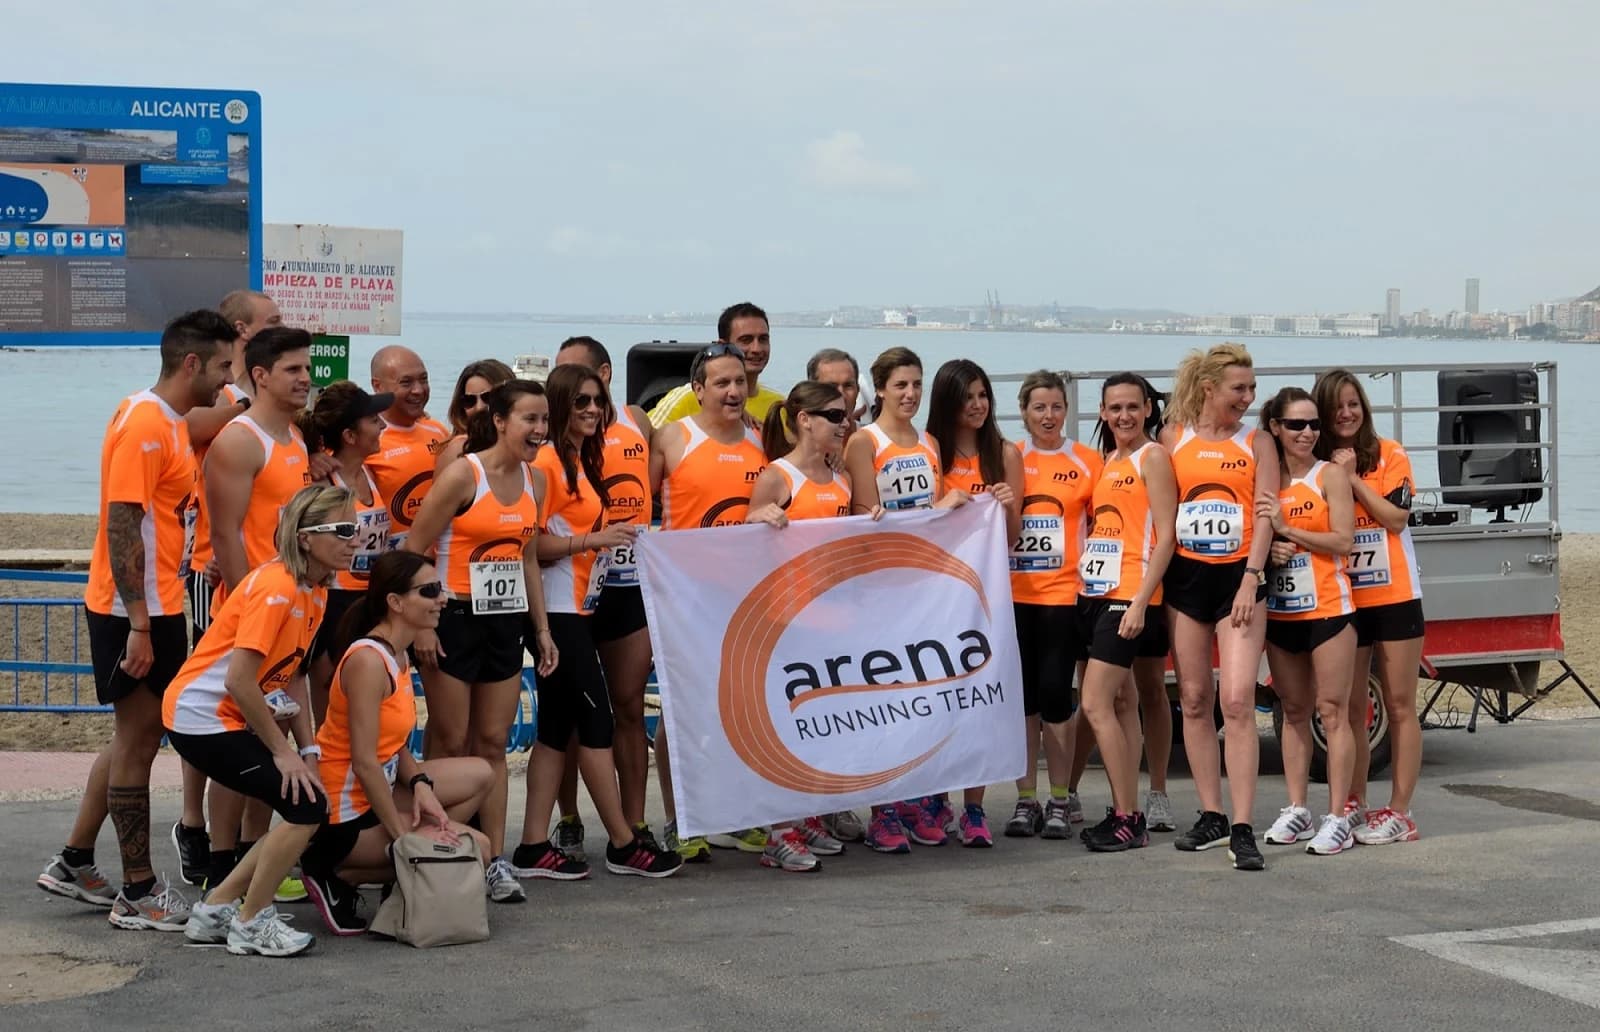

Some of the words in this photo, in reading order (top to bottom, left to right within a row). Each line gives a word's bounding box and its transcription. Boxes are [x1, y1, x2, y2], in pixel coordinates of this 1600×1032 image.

[130, 100, 221, 119] ALICANTE
[282, 261, 341, 274] AYUNTAMIENTO
[345, 264, 355, 275] DE
[358, 264, 396, 277] ALICANTE
[264, 274, 317, 288] MPIEZA
[324, 276, 343, 289] DE
[350, 278, 394, 291] PLAYA
[309, 344, 346, 357] ERROS
[315, 365, 332, 378] NO
[892, 473, 929, 494] 170
[609, 496, 645, 508] rena
[1190, 519, 1231, 536] 110
[1014, 536, 1052, 552] 226
[1086, 560, 1105, 576] 47
[1344, 550, 1376, 569] 77
[484, 579, 516, 597] 107
[1277, 576, 1296, 593] 95
[781, 629, 993, 703] arena
[795, 695, 933, 741] RUNNING
[936, 680, 1005, 713] TEAM
